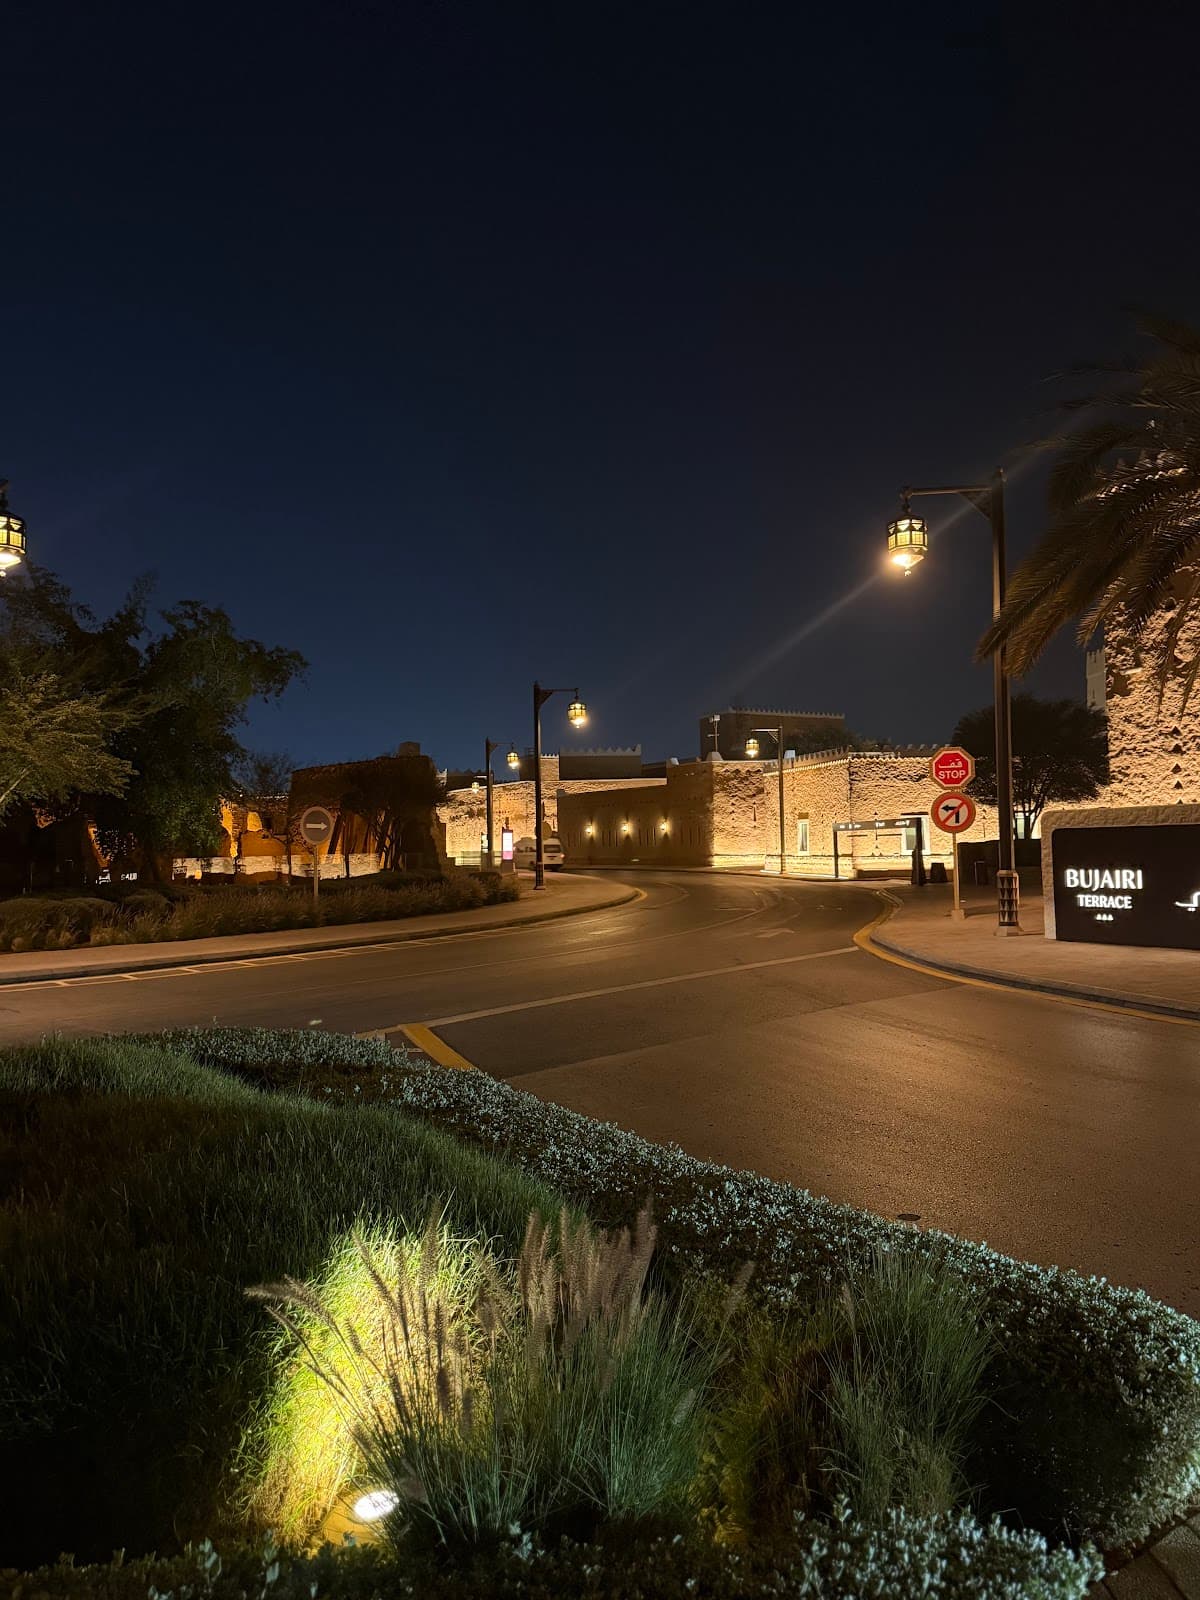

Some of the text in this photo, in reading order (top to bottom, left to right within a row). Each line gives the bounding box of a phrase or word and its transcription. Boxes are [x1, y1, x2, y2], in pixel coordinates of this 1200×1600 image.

[938, 770, 966, 779] STOP
[1065, 868, 1143, 891] BUJAIRI
[1077, 894, 1133, 909] TERRACE
